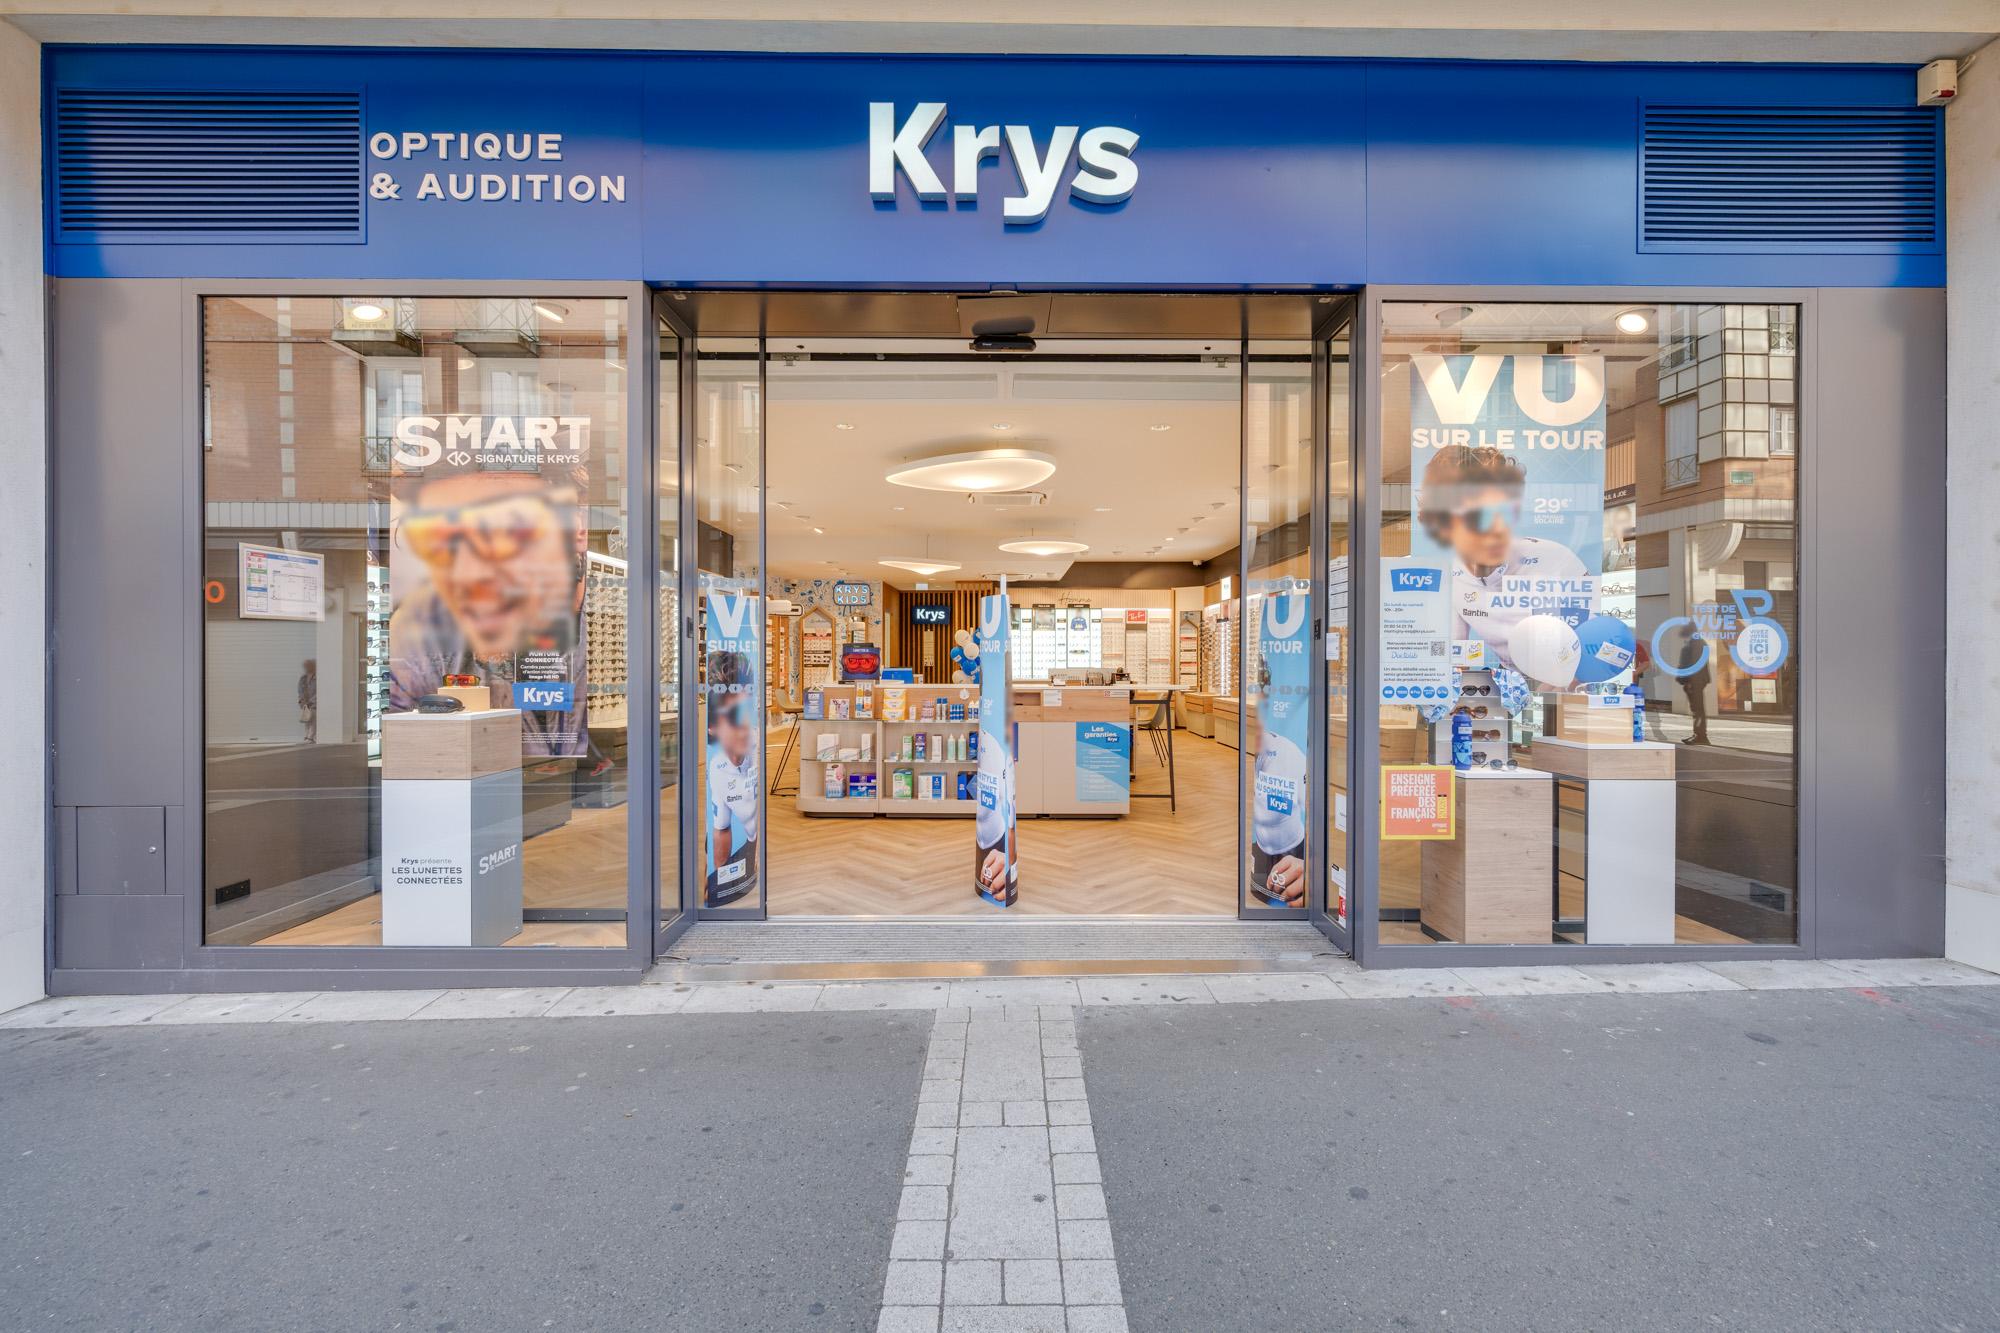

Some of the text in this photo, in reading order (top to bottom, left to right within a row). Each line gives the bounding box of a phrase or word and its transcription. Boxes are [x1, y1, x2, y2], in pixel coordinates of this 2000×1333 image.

[370, 132, 562, 161] OPTIQUE
[869, 102, 1140, 224] Krys
[369, 172, 625, 203] & AUDITION
[1411, 355, 1605, 426] VU
[393, 416, 590, 466] SMART
[1412, 428, 1604, 450] SUR LE TOUR
[475, 454, 579, 463] SIGNATURE KRYS
[1400, 573, 1432, 587] Krys
[1507, 580, 1592, 592] UN STYLE
[835, 585, 869, 594] KRYS
[837, 596, 868, 604] KIDS
[1491, 596, 1592, 608] AU SOMMET
[916, 608, 945, 621] Krys
[1693, 605, 1736, 613] TEST DE
[1692, 614, 1736, 630] VUE
[707, 640, 736, 652] SUR
[1268, 640, 1303, 654] TOUR
[1749, 644, 1768, 654] ICI
[523, 687, 564, 706] Krys
[1084, 731, 1117, 739] garanties
[1268, 776, 1295, 789] STYLE
[1391, 773, 1436, 784] ENSEIGNE
[1263, 785, 1294, 799] SOMMET
[1270, 798, 1288, 810] Krys
[1418, 796, 1436, 807] DES
[1391, 807, 1436, 822] FRANÇAIS
[479, 845, 517, 875] SMART
[396, 876, 463, 884] CONNECTÉES
